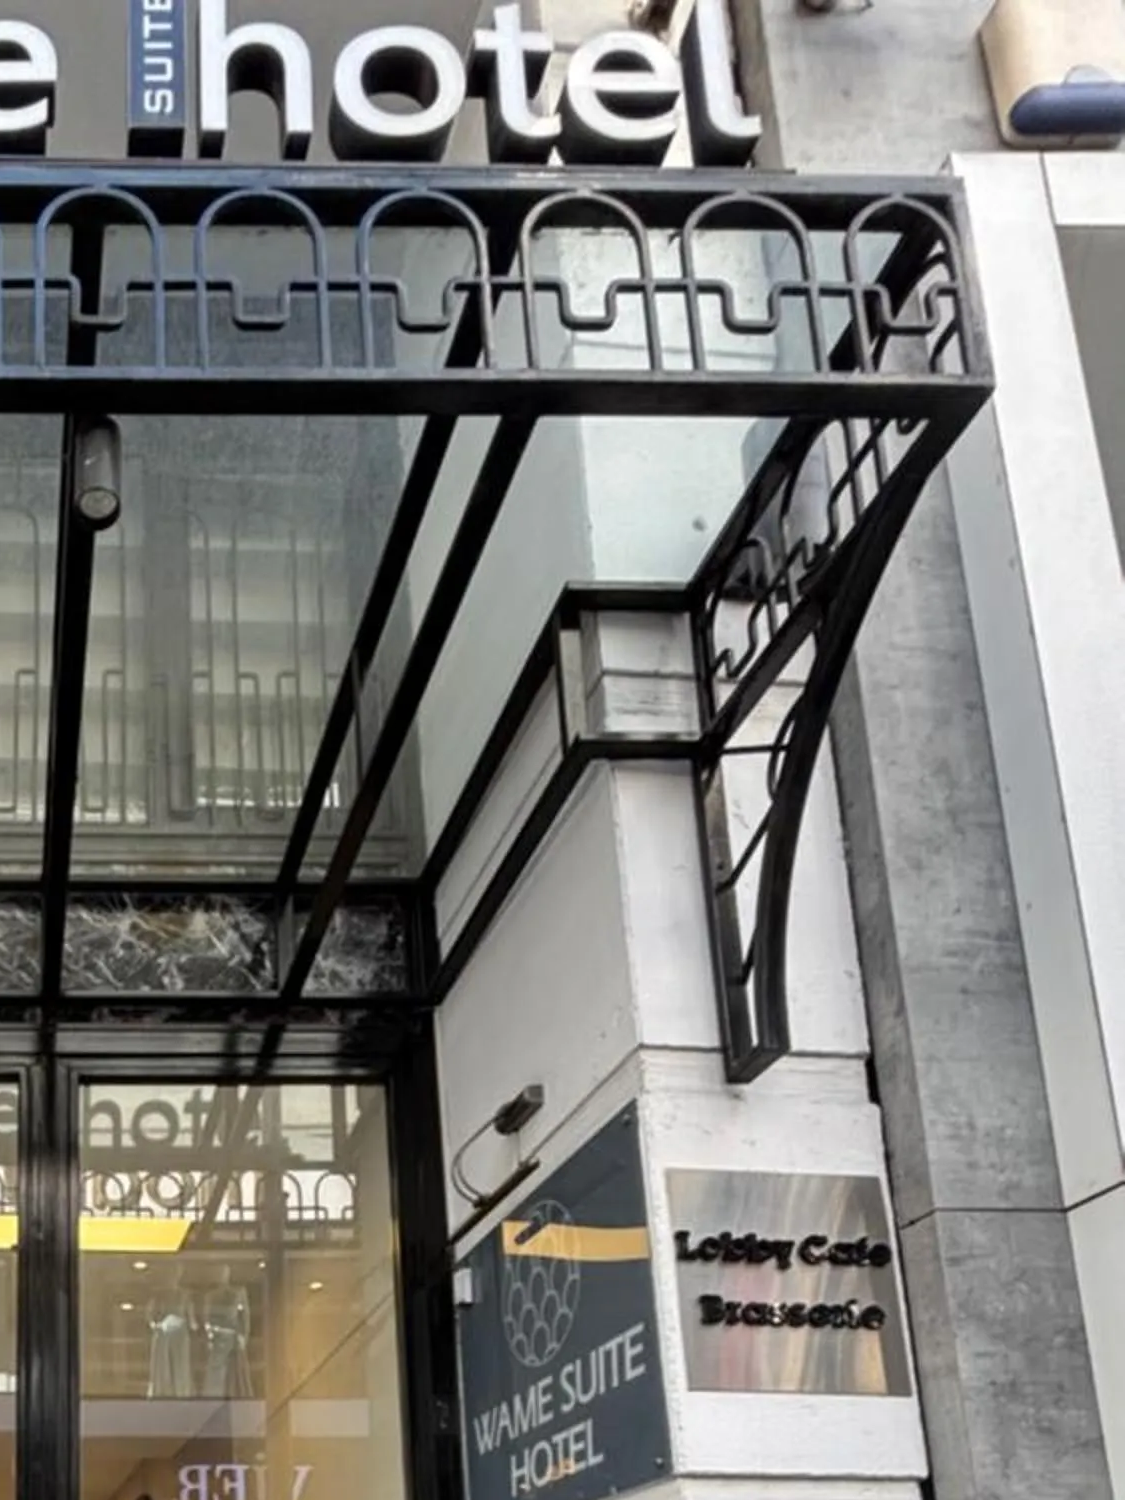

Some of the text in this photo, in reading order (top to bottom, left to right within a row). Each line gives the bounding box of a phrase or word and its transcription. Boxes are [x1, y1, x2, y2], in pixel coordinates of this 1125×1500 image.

[142, 0, 174, 114] SUITE
[197, 0, 762, 138] hotel
[675, 1229, 795, 1270] Lobby
[699, 1294, 885, 1329] Brasserie
[473, 1321, 647, 1456] WAME SUITE
[509, 1417, 604, 1498] HOTEL
